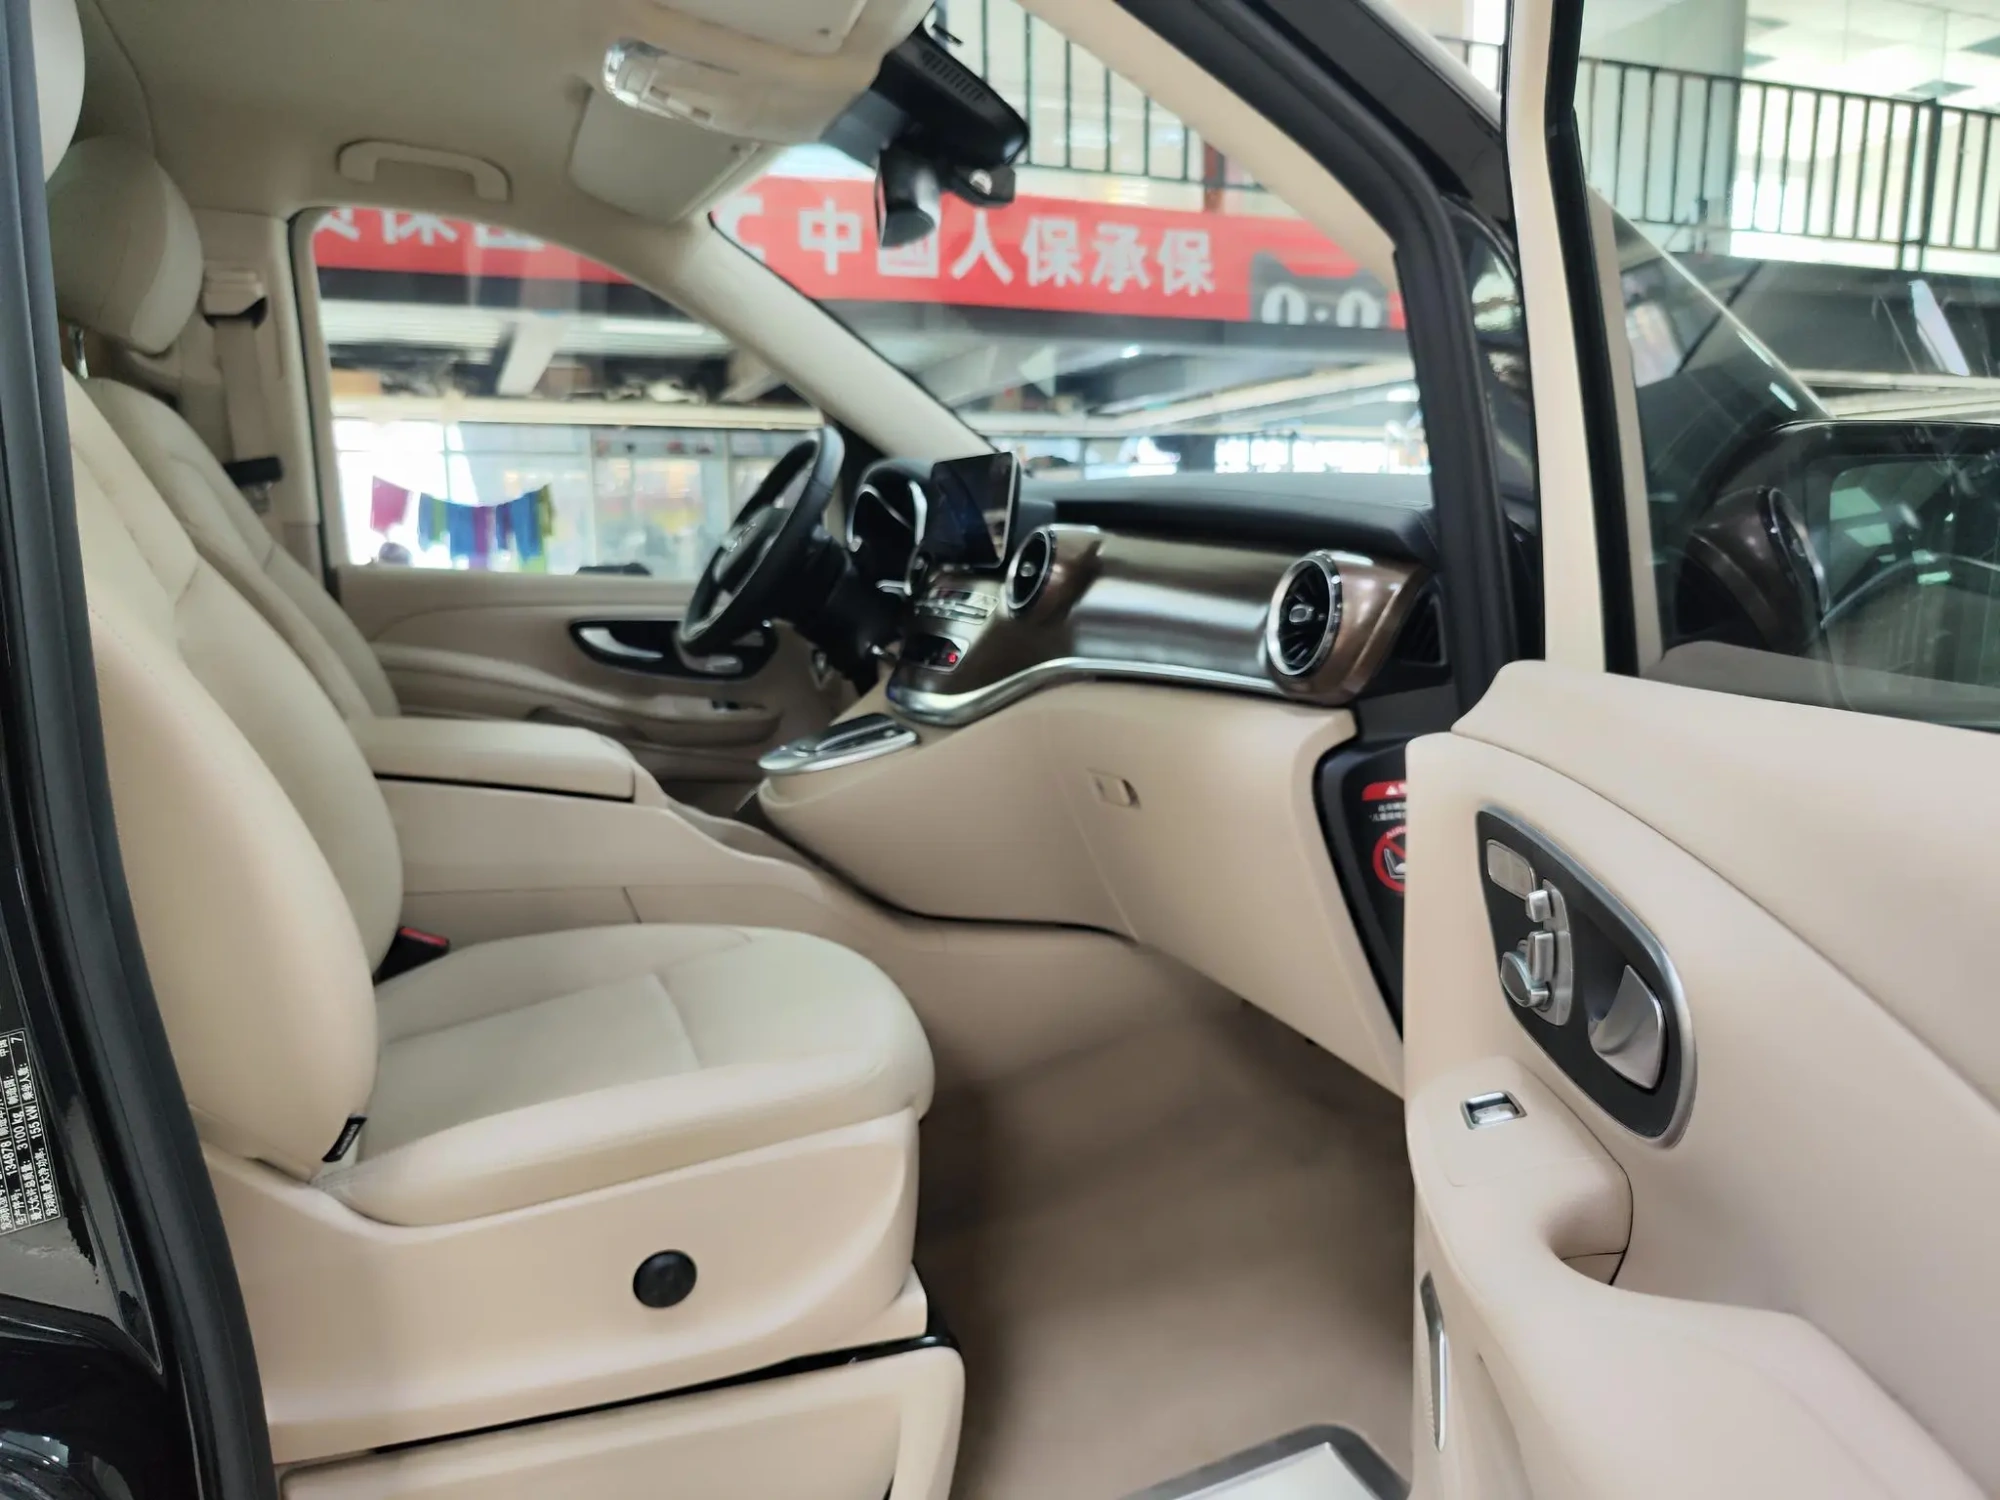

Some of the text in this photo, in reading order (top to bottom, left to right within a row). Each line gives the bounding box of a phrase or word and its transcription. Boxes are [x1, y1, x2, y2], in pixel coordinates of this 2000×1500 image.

[12, 1110, 25, 1126] kg
[25, 1105, 39, 1121] kW
[13, 1126, 28, 1150] 3100
[28, 1121, 42, 1139] 155
[1, 1140, 18, 1176] 134878
